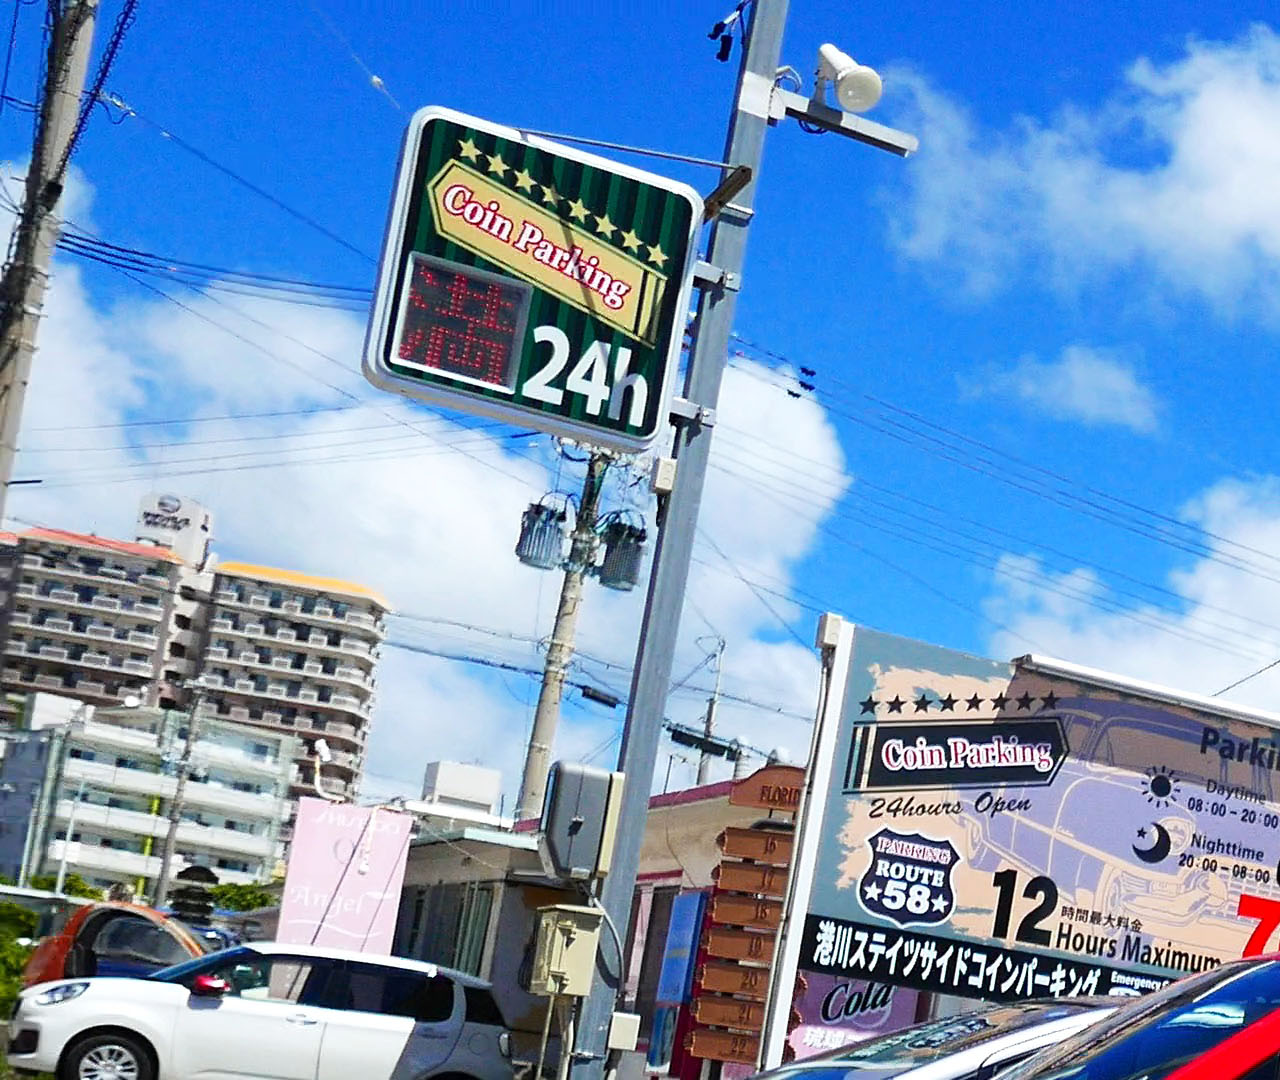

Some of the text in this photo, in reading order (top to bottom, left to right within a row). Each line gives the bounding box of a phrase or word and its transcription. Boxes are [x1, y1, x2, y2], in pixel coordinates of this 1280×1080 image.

[443, 184, 632, 310] Coin Parking
[521, 325, 649, 428] 24h
[881, 735, 1053, 772] Coin Parking
[869, 792, 1032, 818] 24hours Open
[1206, 779, 1267, 805] Daytime
[1187, 797, 1227, 818] 08:00
[1240, 808, 1279, 829] 20:00
[876, 836, 951, 864] PARKING
[1191, 833, 1265, 863] Nighttime
[875, 859, 945, 888] ROUTE
[1179, 853, 1218, 875] 20:00
[1232, 863, 1270, 884] 08:00
[881, 881, 931, 914] 58
[992, 868, 1059, 947] 12
[1061, 905, 1144, 934] 時間最大料金
[813, 920, 1102, 998] 港川ステイツサイドコインパーキング
[1055, 922, 1222, 974] Hours Maximum
[1111, 970, 1162, 993] Emergency
